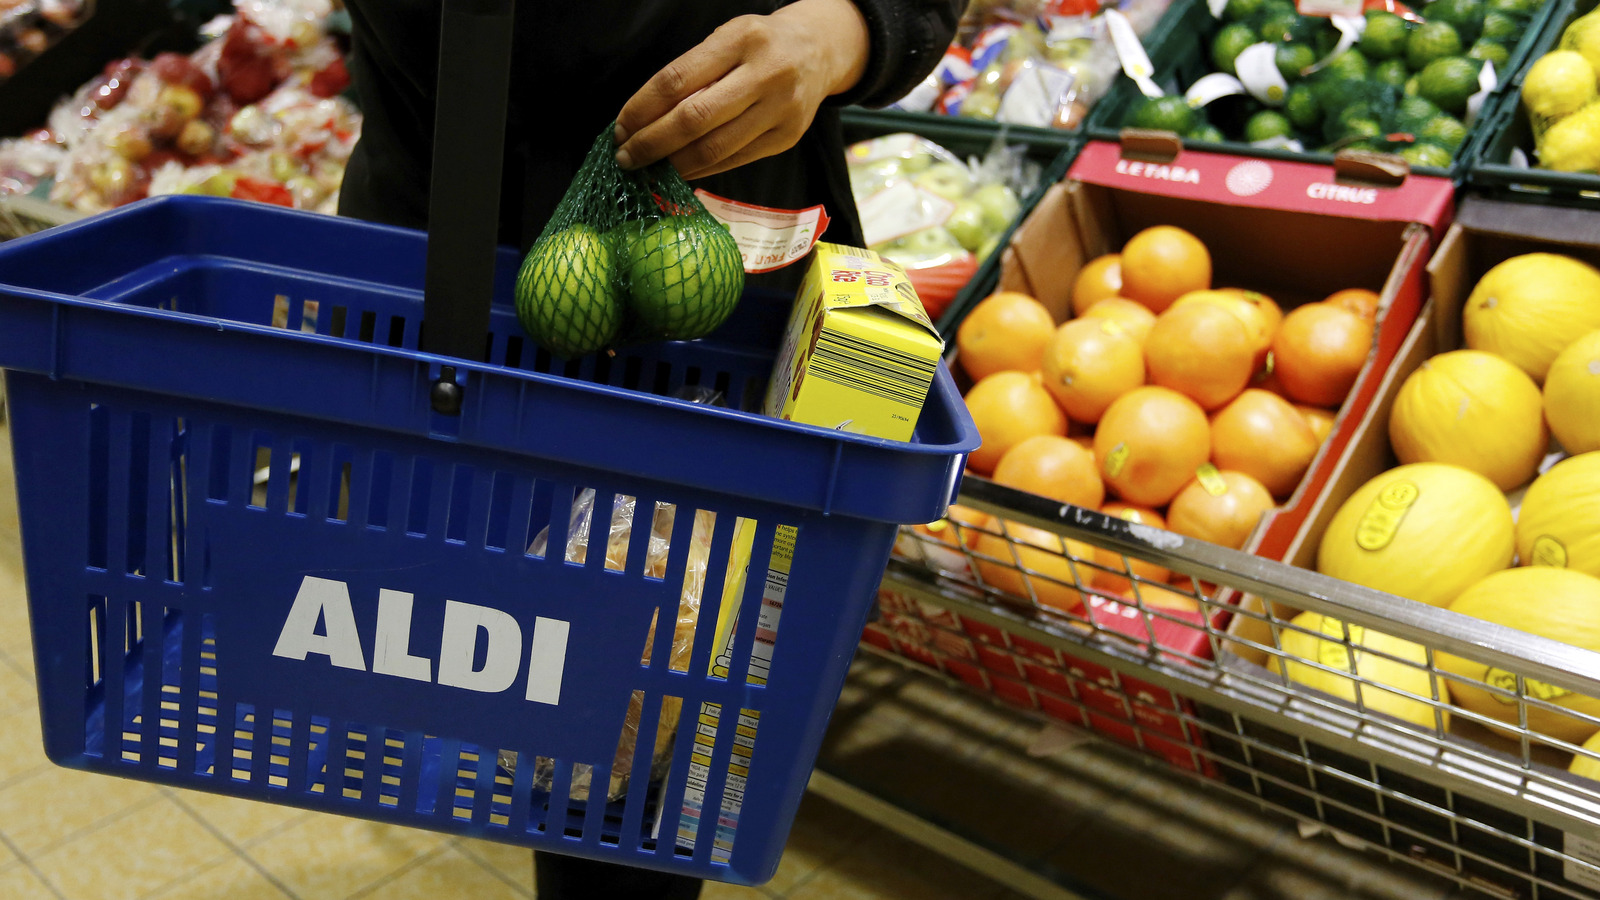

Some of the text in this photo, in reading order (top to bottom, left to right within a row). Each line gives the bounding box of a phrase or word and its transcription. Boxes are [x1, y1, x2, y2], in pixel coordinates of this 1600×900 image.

[1115, 159, 1378, 205] LETABA CITRUS
[753, 252, 785, 265] FRUIT
[783, 533, 797, 541] syste
[773, 544, 789, 553] ortant
[768, 584, 783, 593] VALUES
[272, 575, 571, 706] ALDI
[687, 780, 704, 789] uideline
